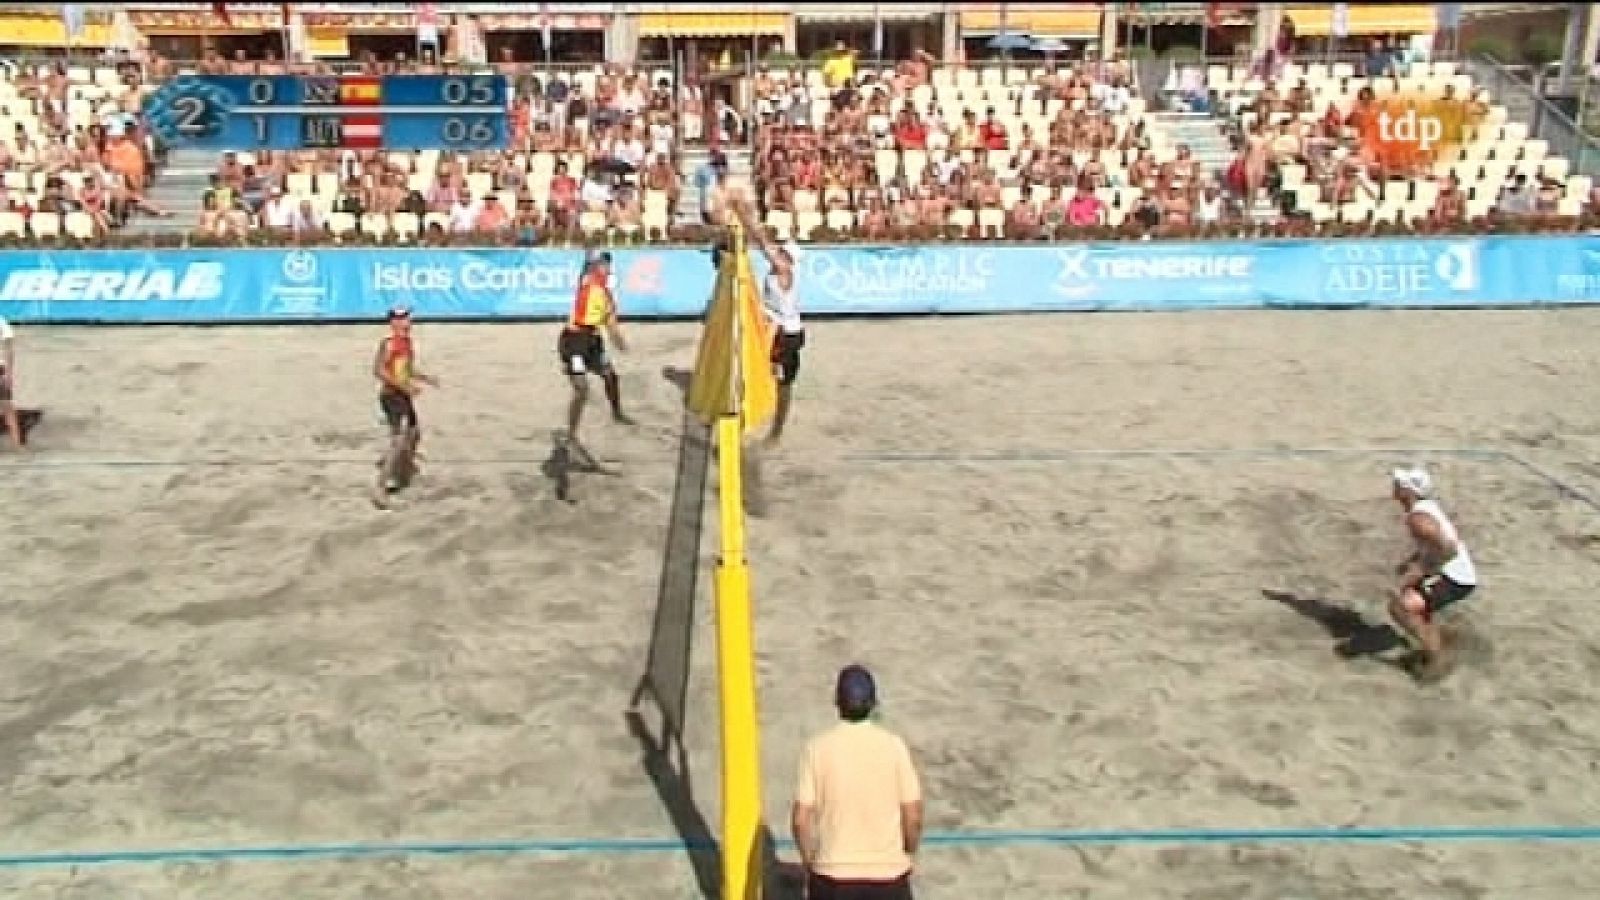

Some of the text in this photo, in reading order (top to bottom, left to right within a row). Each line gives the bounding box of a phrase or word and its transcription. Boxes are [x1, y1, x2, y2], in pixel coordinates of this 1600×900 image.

[1322, 244, 1429, 262] COSTA
[1, 270, 176, 300] IBERIA
[374, 261, 450, 290] Islas
[1325, 264, 1433, 297] ADEJE
